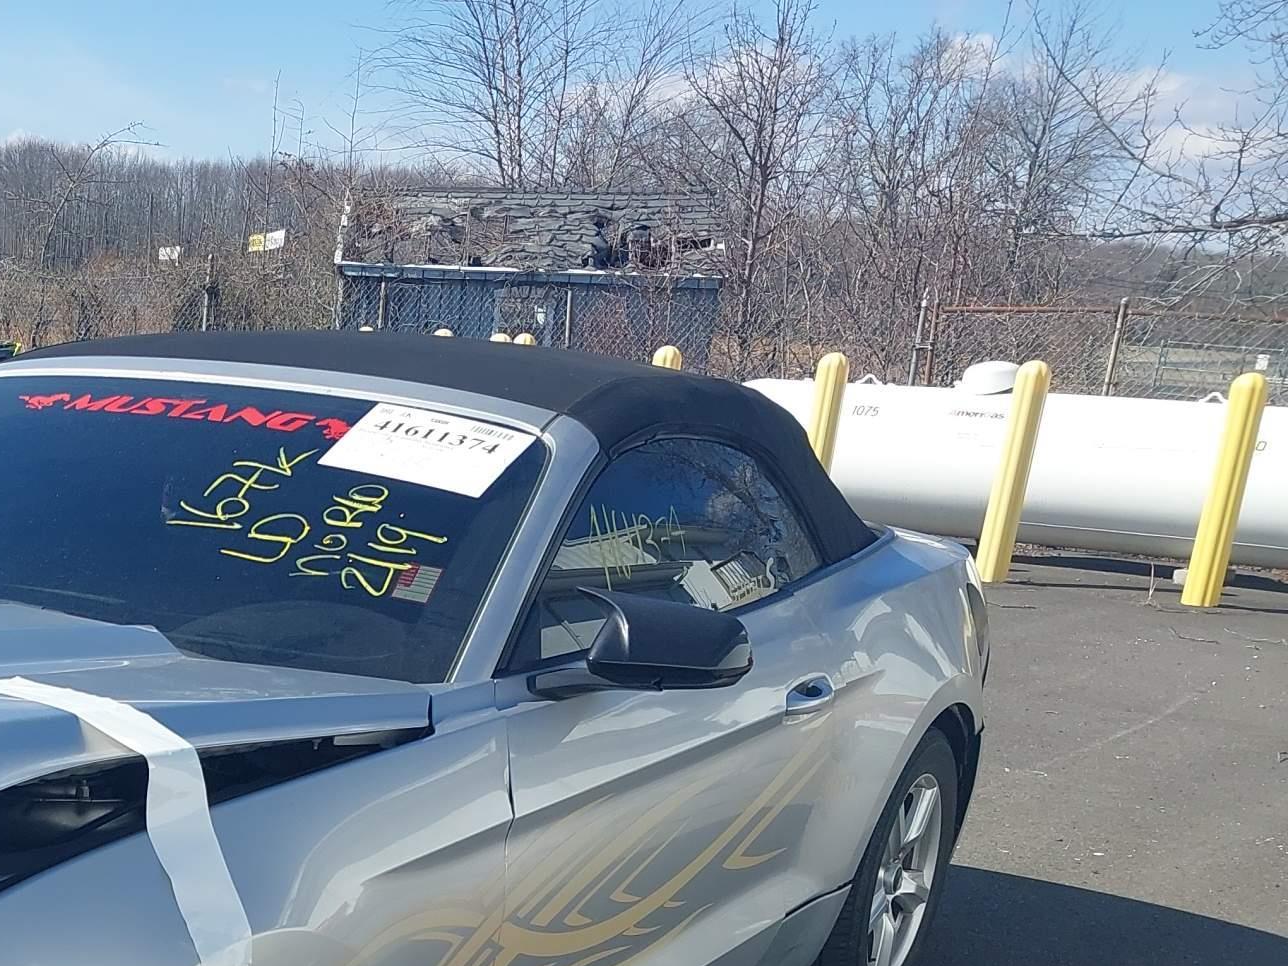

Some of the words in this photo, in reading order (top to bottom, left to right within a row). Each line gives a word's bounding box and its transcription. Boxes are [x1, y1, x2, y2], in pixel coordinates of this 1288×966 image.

[63, 394, 316, 432] MUSTANG
[851, 404, 880, 417] 1075
[373, 415, 501, 455] 41611374
